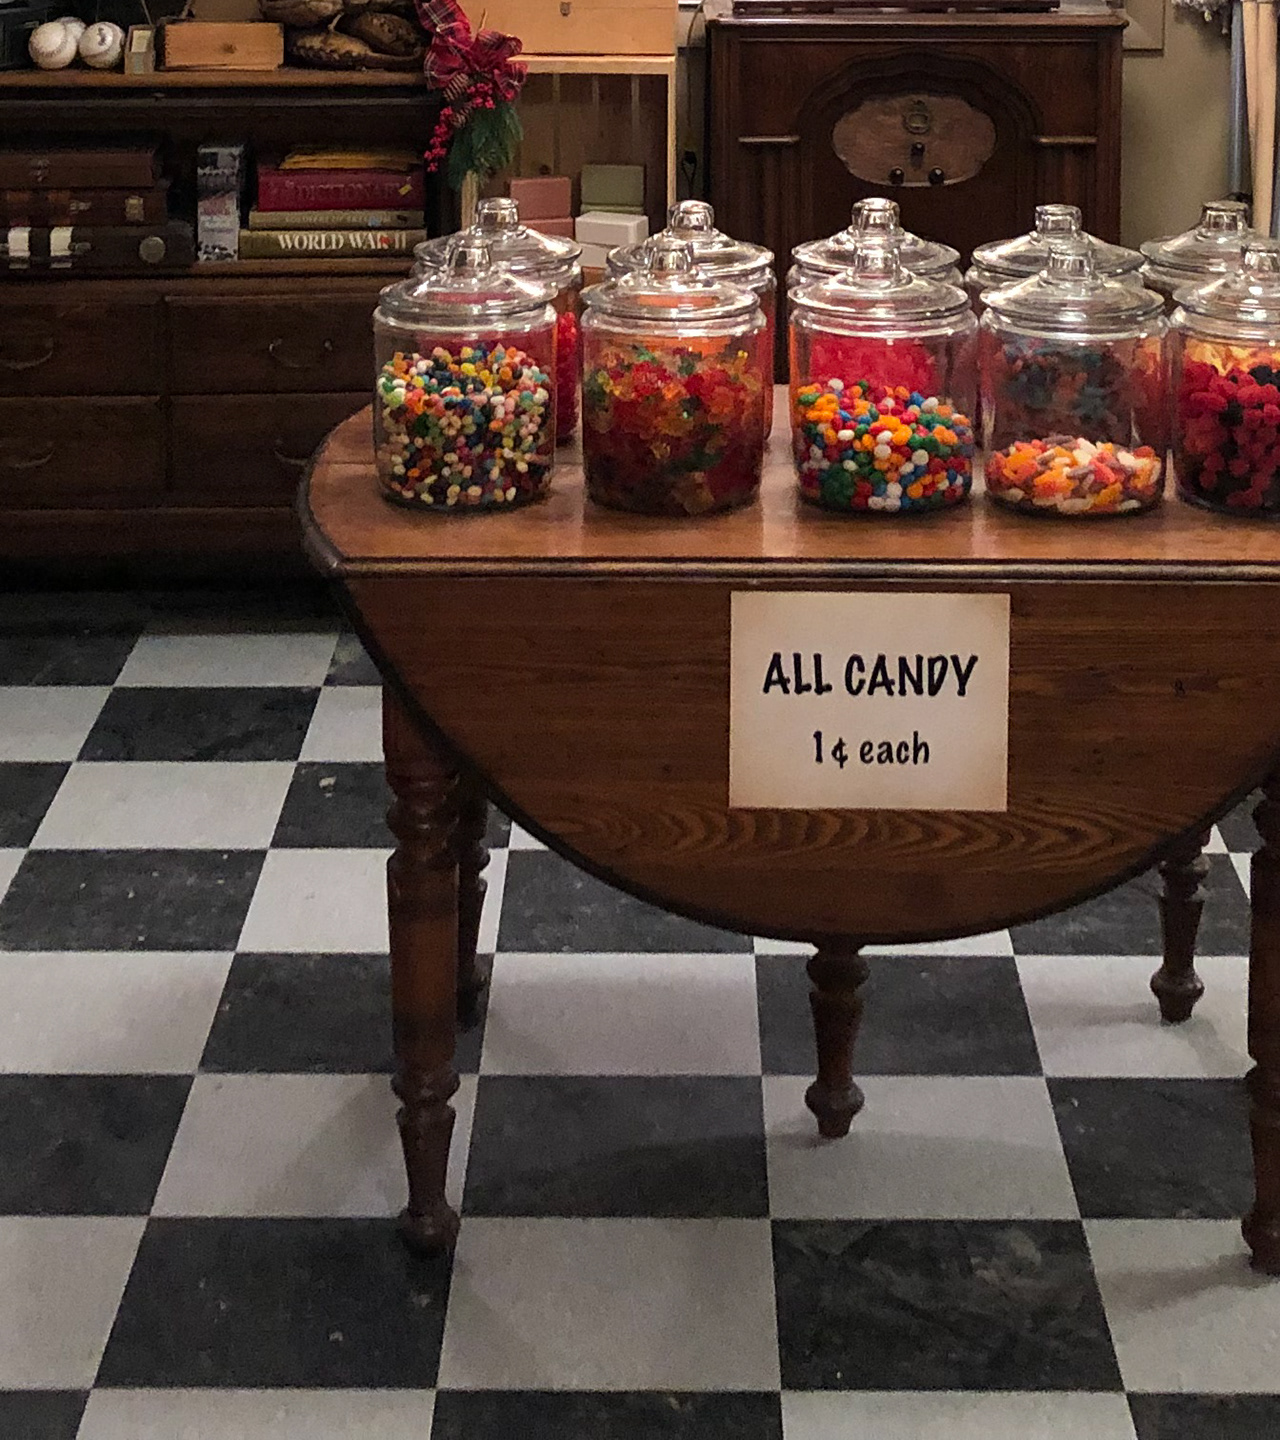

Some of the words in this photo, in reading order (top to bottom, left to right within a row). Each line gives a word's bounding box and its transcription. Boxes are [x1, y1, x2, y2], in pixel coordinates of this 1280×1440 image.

[277, 233, 344, 251] WORLD
[349, 233, 389, 250] WAR
[394, 232, 406, 249] II
[763, 652, 833, 695] ALL
[844, 653, 980, 697] CANDY
[859, 730, 931, 766] each
